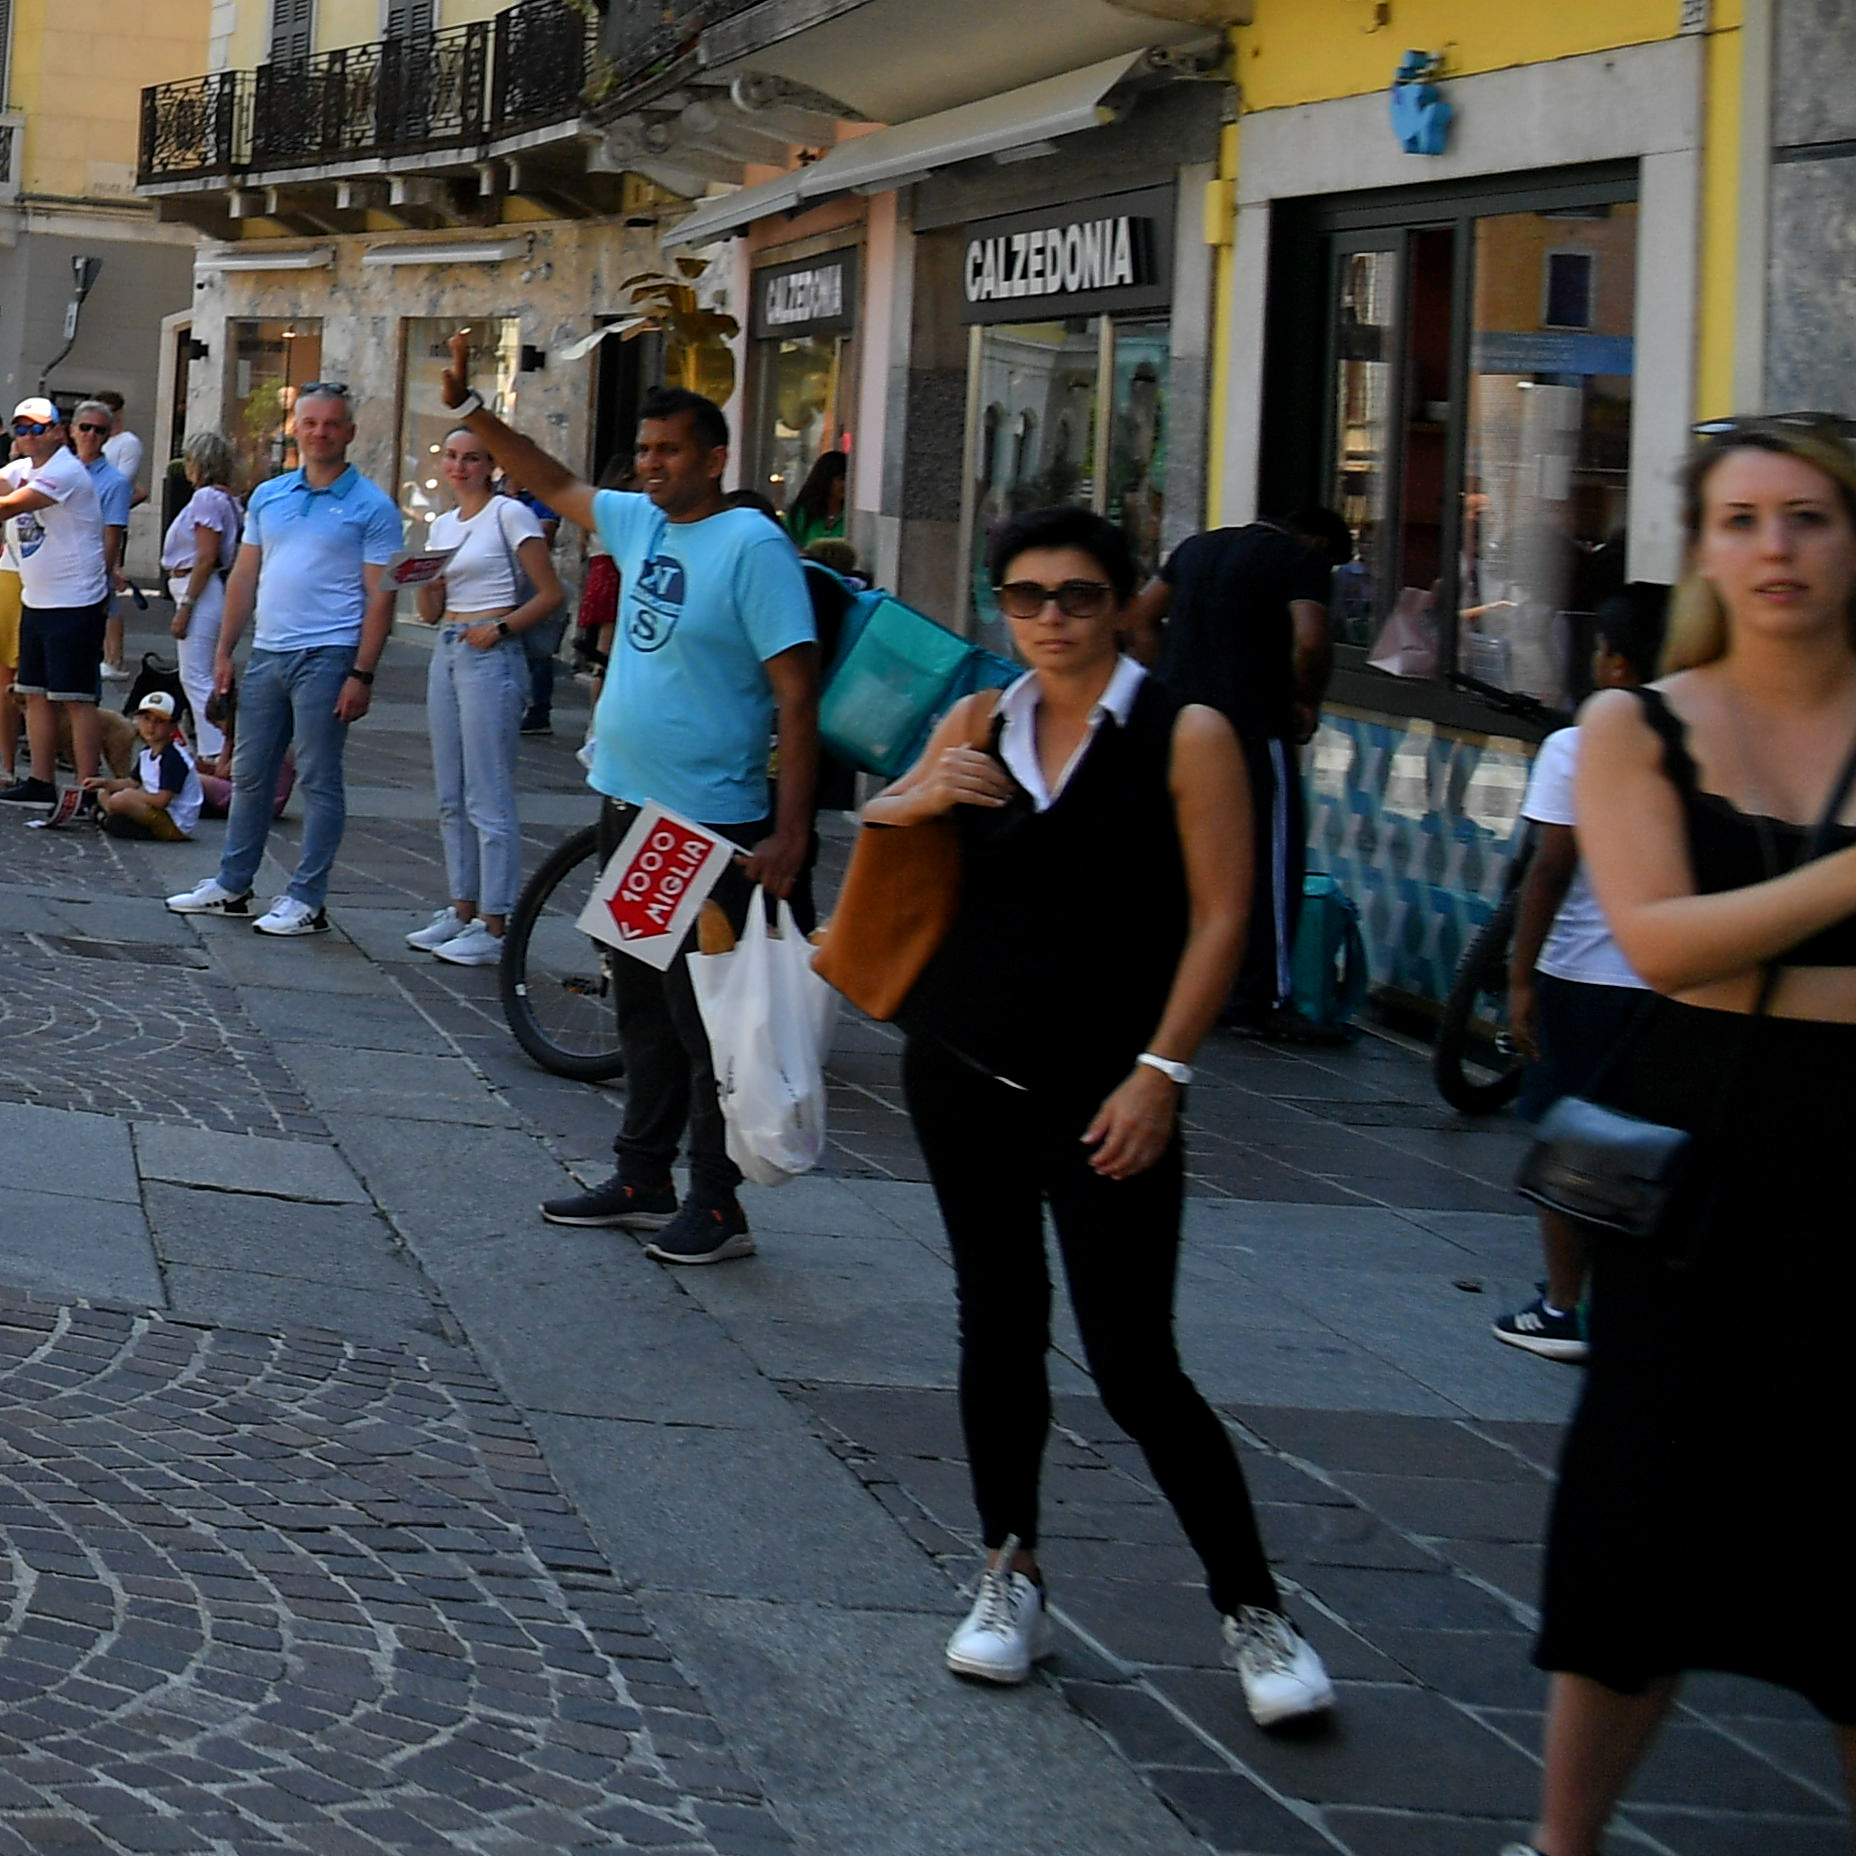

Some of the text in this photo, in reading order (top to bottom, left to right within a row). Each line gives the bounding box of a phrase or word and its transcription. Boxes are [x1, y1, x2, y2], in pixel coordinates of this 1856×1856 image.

[965, 216, 1132, 301] CALZEDONIA
[620, 831, 676, 902] 1000
[645, 840, 709, 925] MIGLIA
